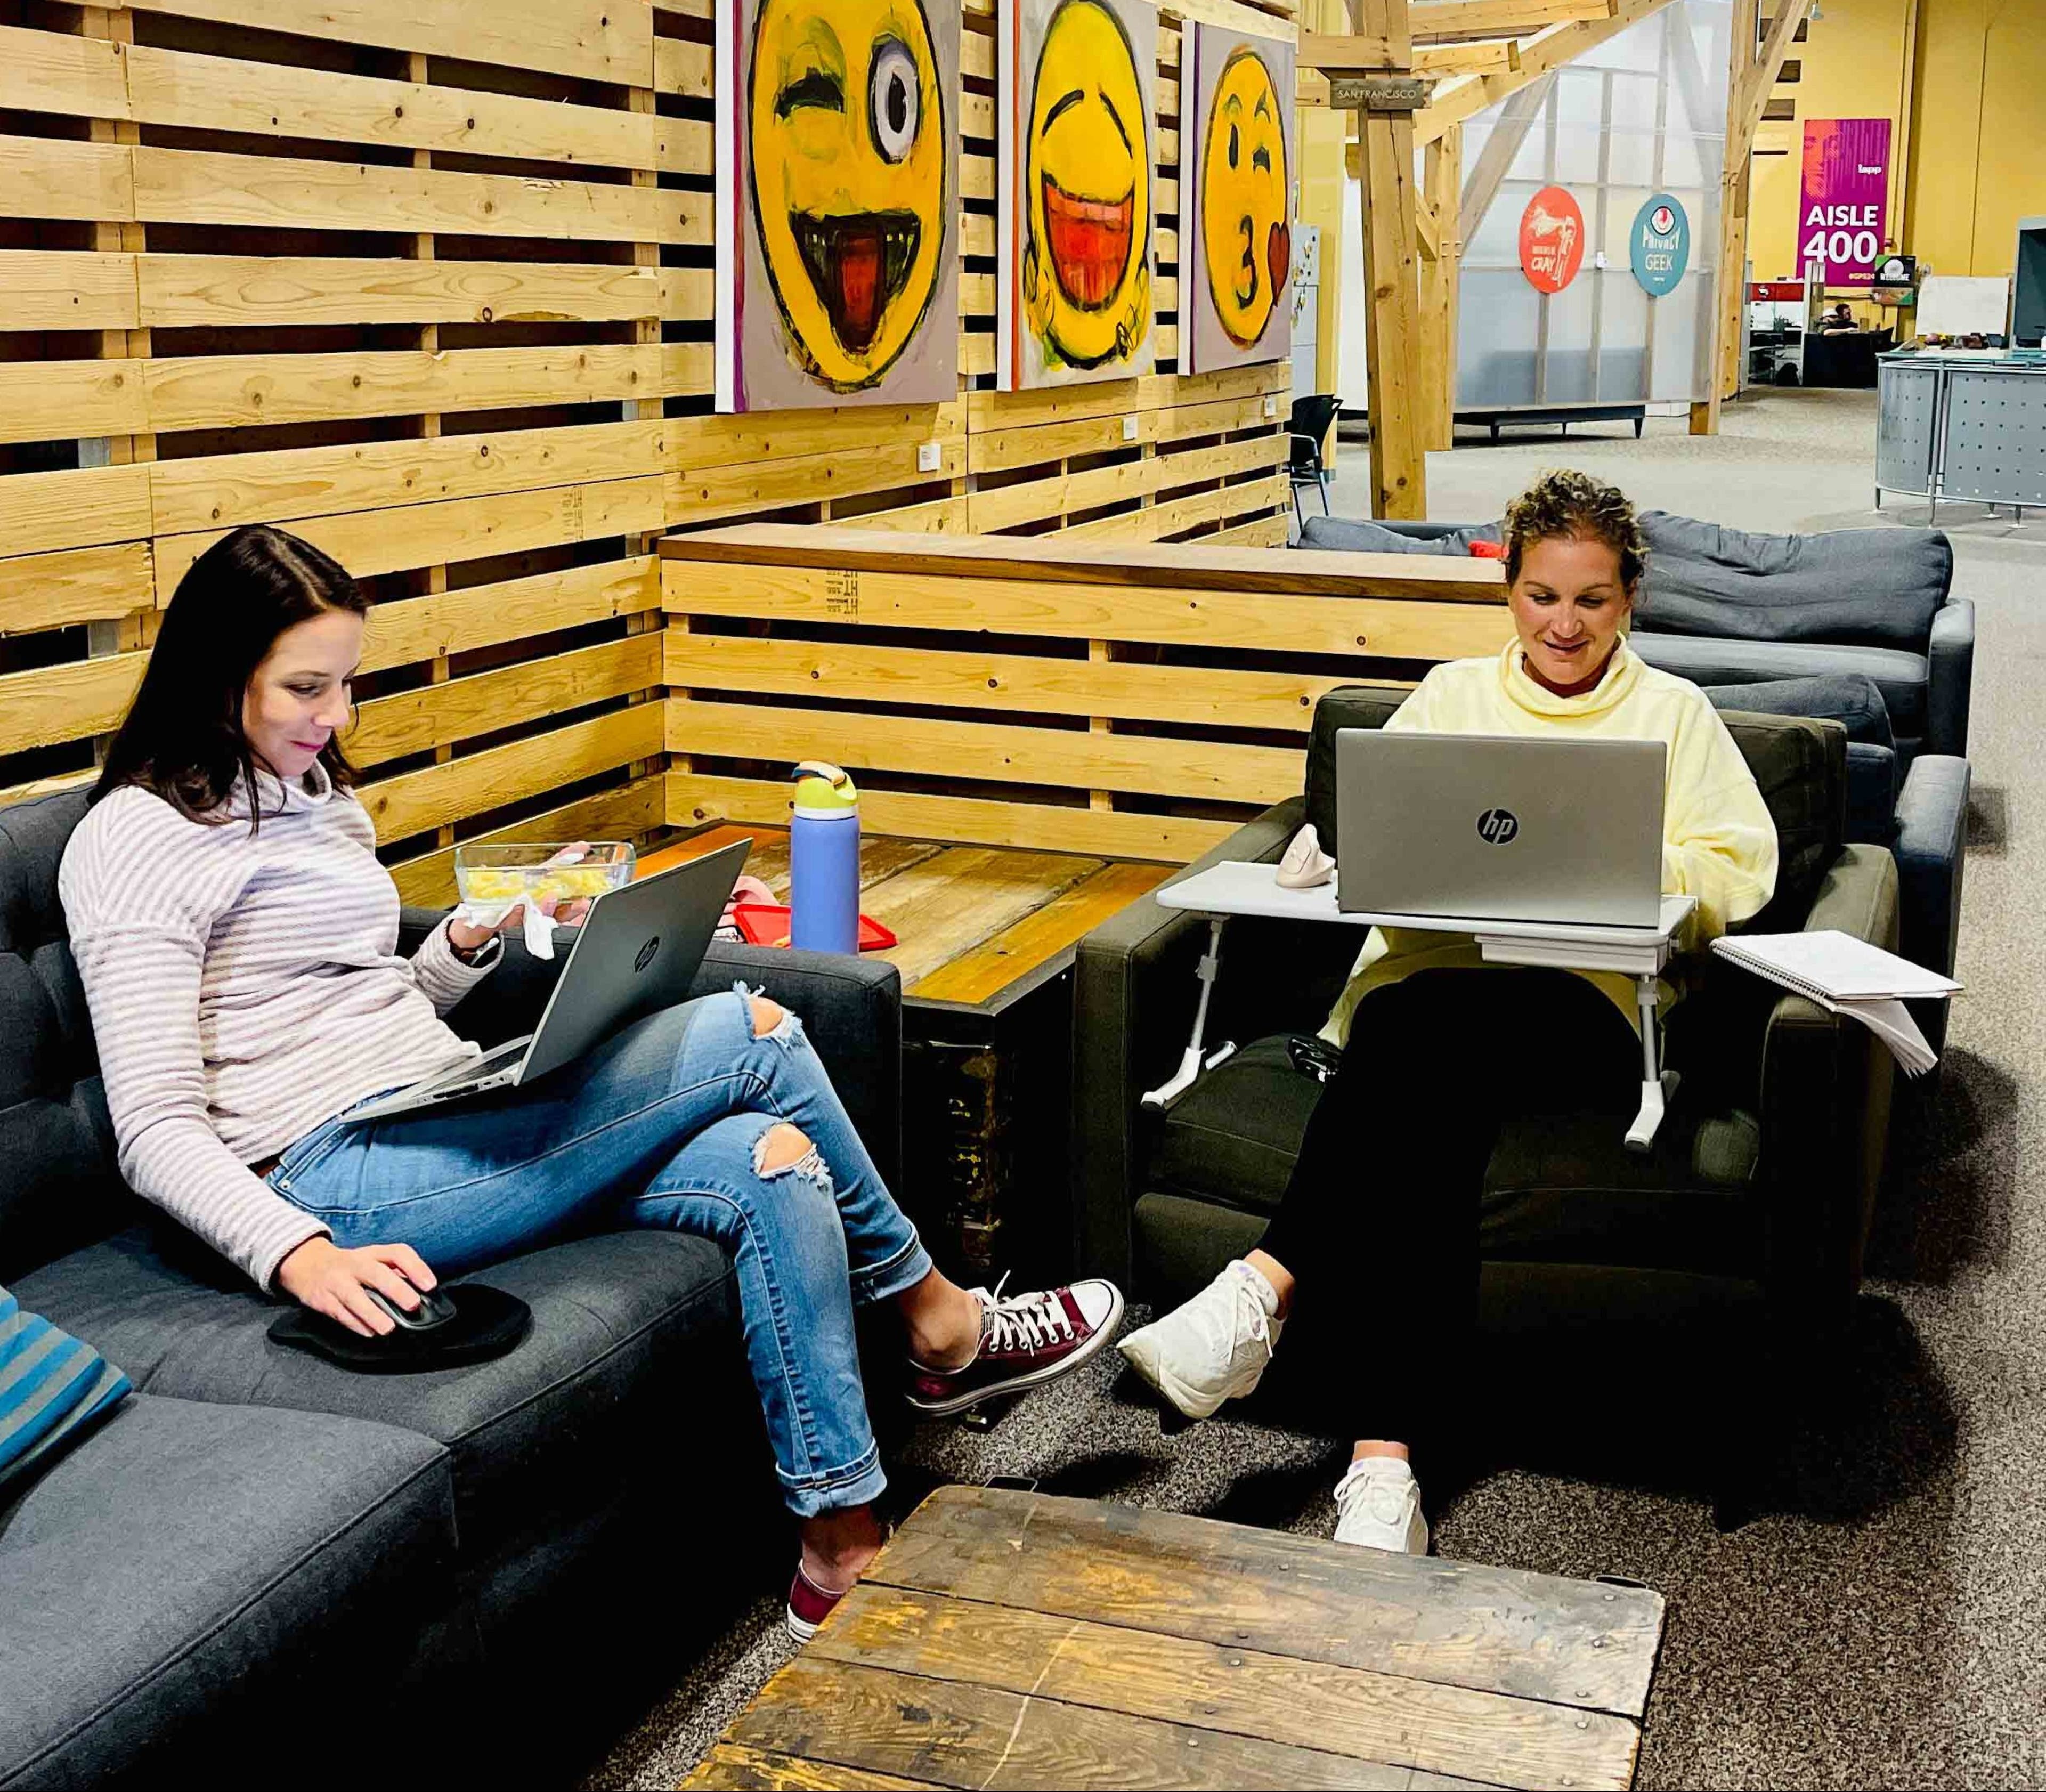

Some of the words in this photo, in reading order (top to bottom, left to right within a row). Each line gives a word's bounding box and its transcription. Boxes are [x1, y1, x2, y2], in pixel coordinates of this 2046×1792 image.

[1337, 89, 1358, 99] SAN
[1359, 89, 1416, 99] FRANCISCO
[1806, 205, 1879, 226] AISLE
[1642, 224, 1681, 250] PRIVACY
[1803, 231, 1878, 264] 400
[1645, 254, 1673, 271] GEEK
[1482, 809, 1514, 844] hp
